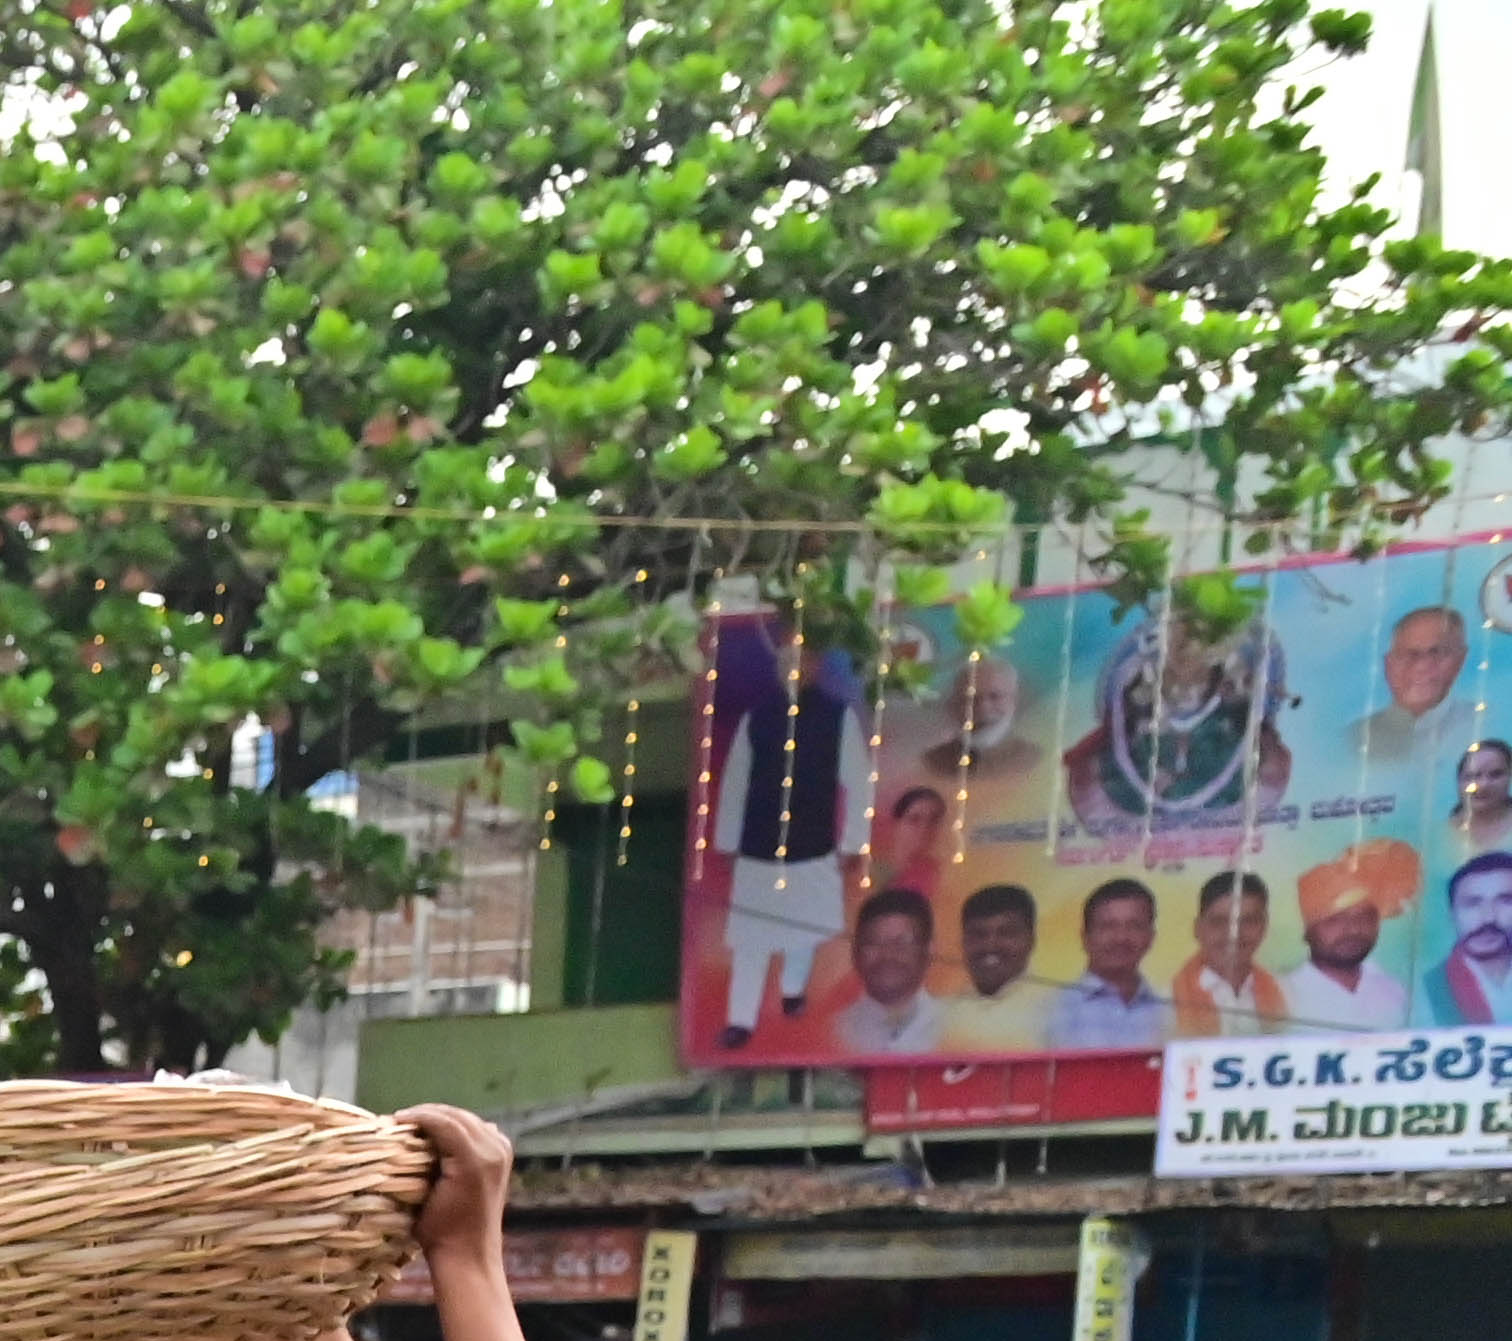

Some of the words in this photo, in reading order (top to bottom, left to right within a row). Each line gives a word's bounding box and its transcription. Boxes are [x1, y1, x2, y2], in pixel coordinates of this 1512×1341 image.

[1213, 1051, 1361, 1089] S.G.K.
[1175, 1109, 1279, 1144] J.M.
[1292, 1099, 1468, 1140] ಮಂಜು
